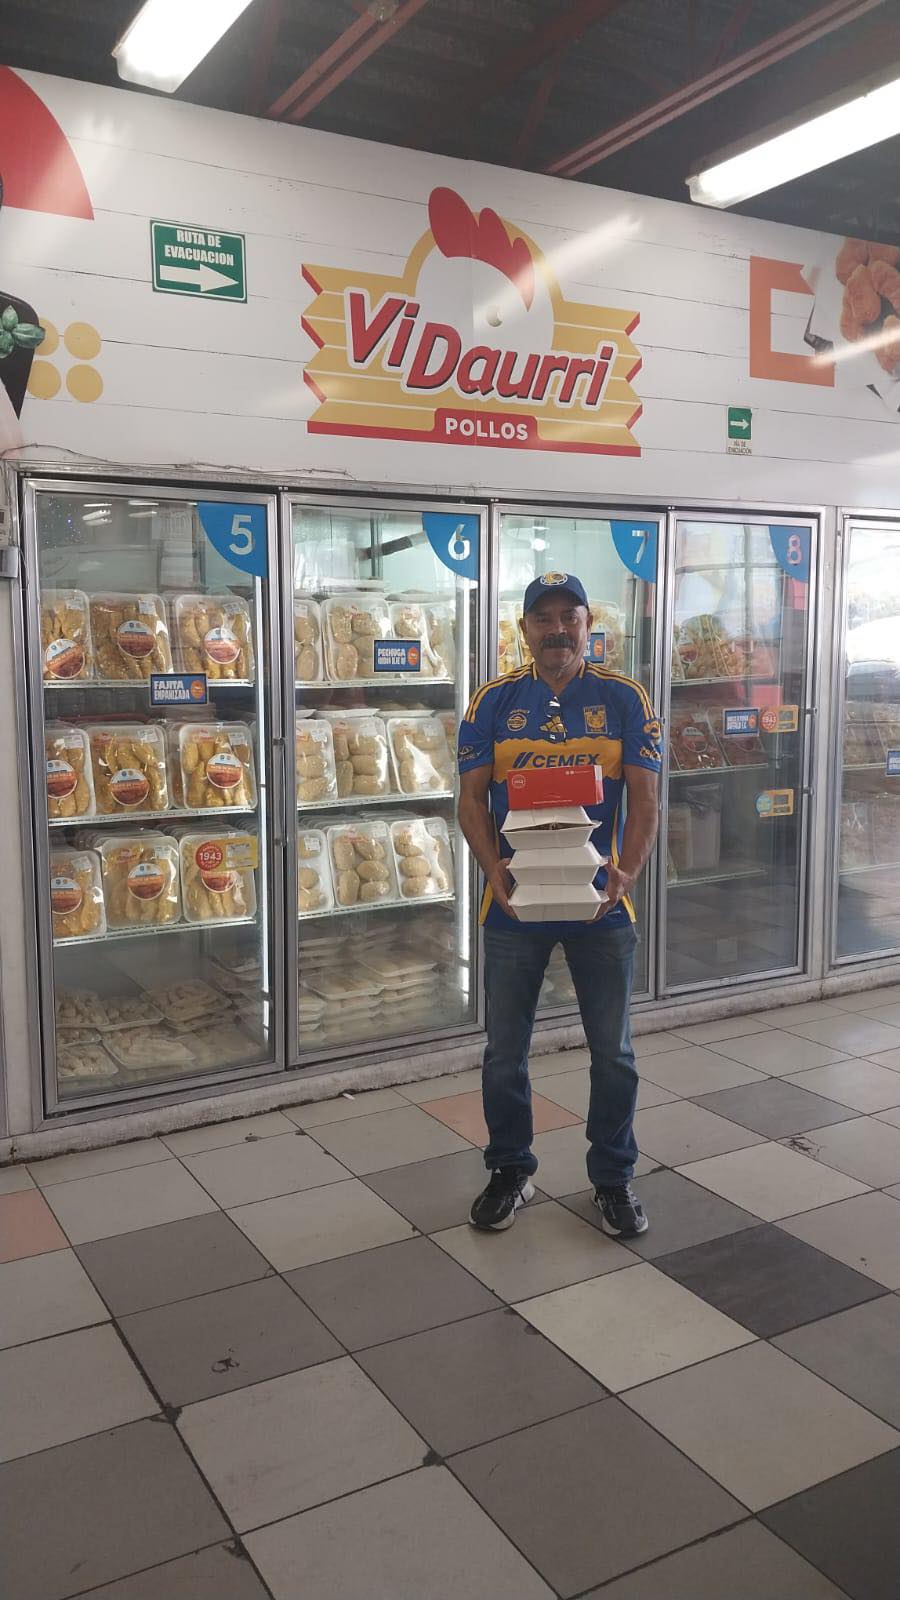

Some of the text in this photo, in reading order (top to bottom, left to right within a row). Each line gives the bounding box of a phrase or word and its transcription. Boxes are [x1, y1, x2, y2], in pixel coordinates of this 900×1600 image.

[176, 229, 222, 248] RUTA DE
[445, 417, 529, 440] POLLOS
[229, 514, 252, 555] 5
[448, 523, 470, 561] 6
[632, 530, 650, 564] 7
[786, 534, 802, 566] 8
[153, 680, 184, 690] FAJITA
[532, 753, 600, 768] CEMEX
[199, 851, 222, 861] 1943
